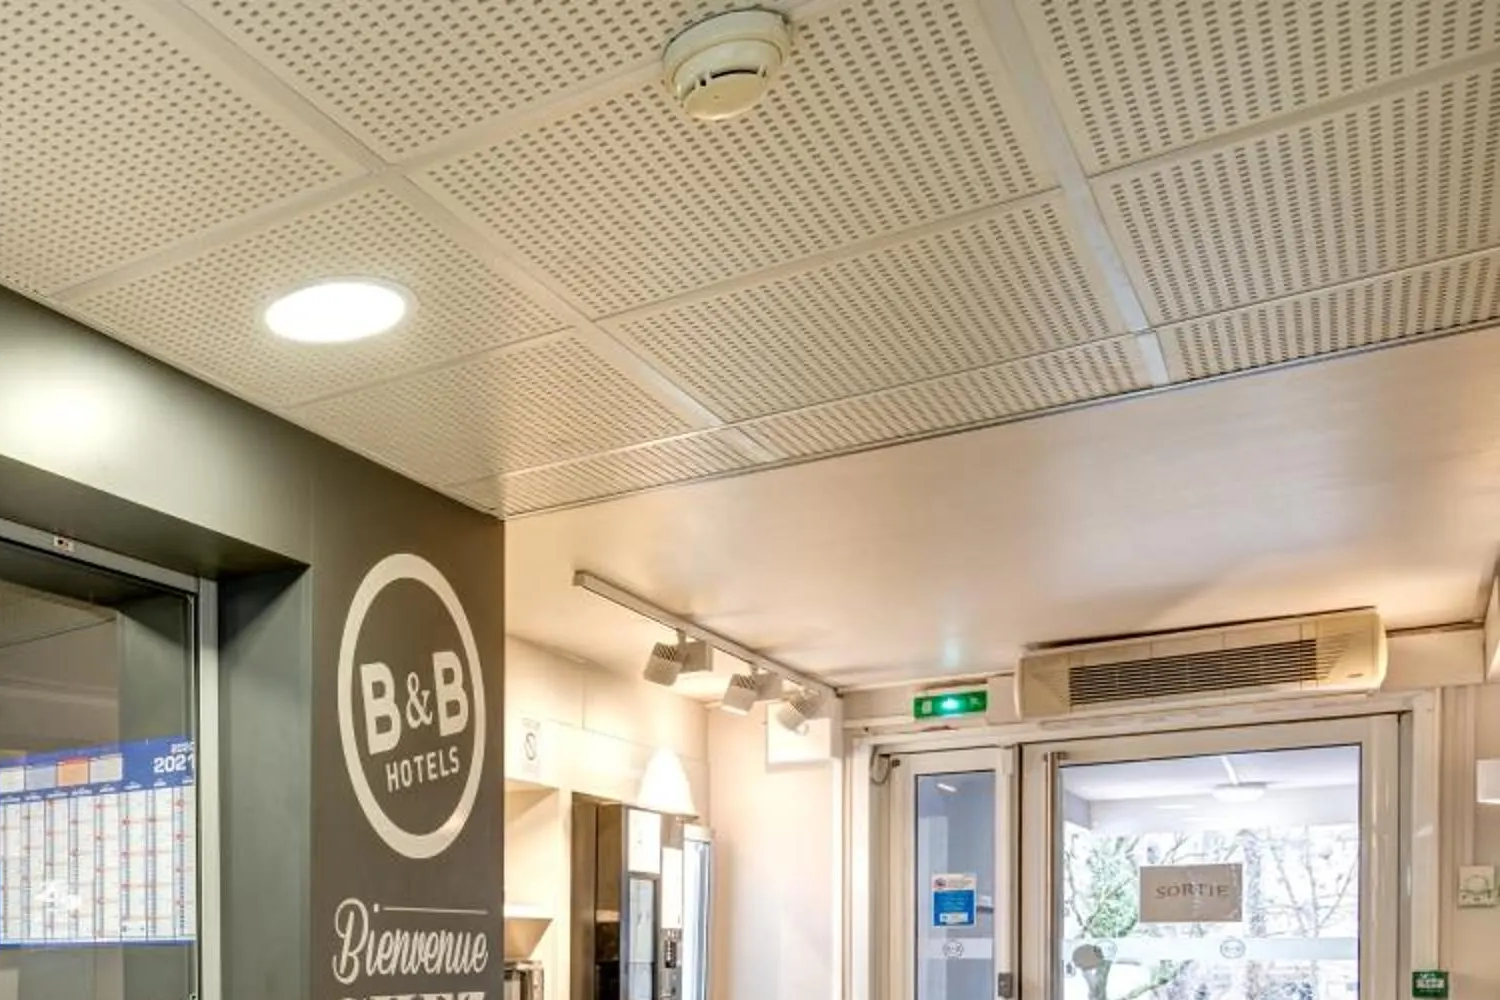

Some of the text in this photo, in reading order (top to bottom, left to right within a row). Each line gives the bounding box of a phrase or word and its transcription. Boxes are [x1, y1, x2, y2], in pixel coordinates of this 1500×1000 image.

[360, 650, 469, 755] B&B
[153, 753, 195, 773] 2021
[385, 745, 461, 792] HOTELS
[1155, 883, 1230, 899] SORTIE
[332, 898, 488, 984] Bienvenue
